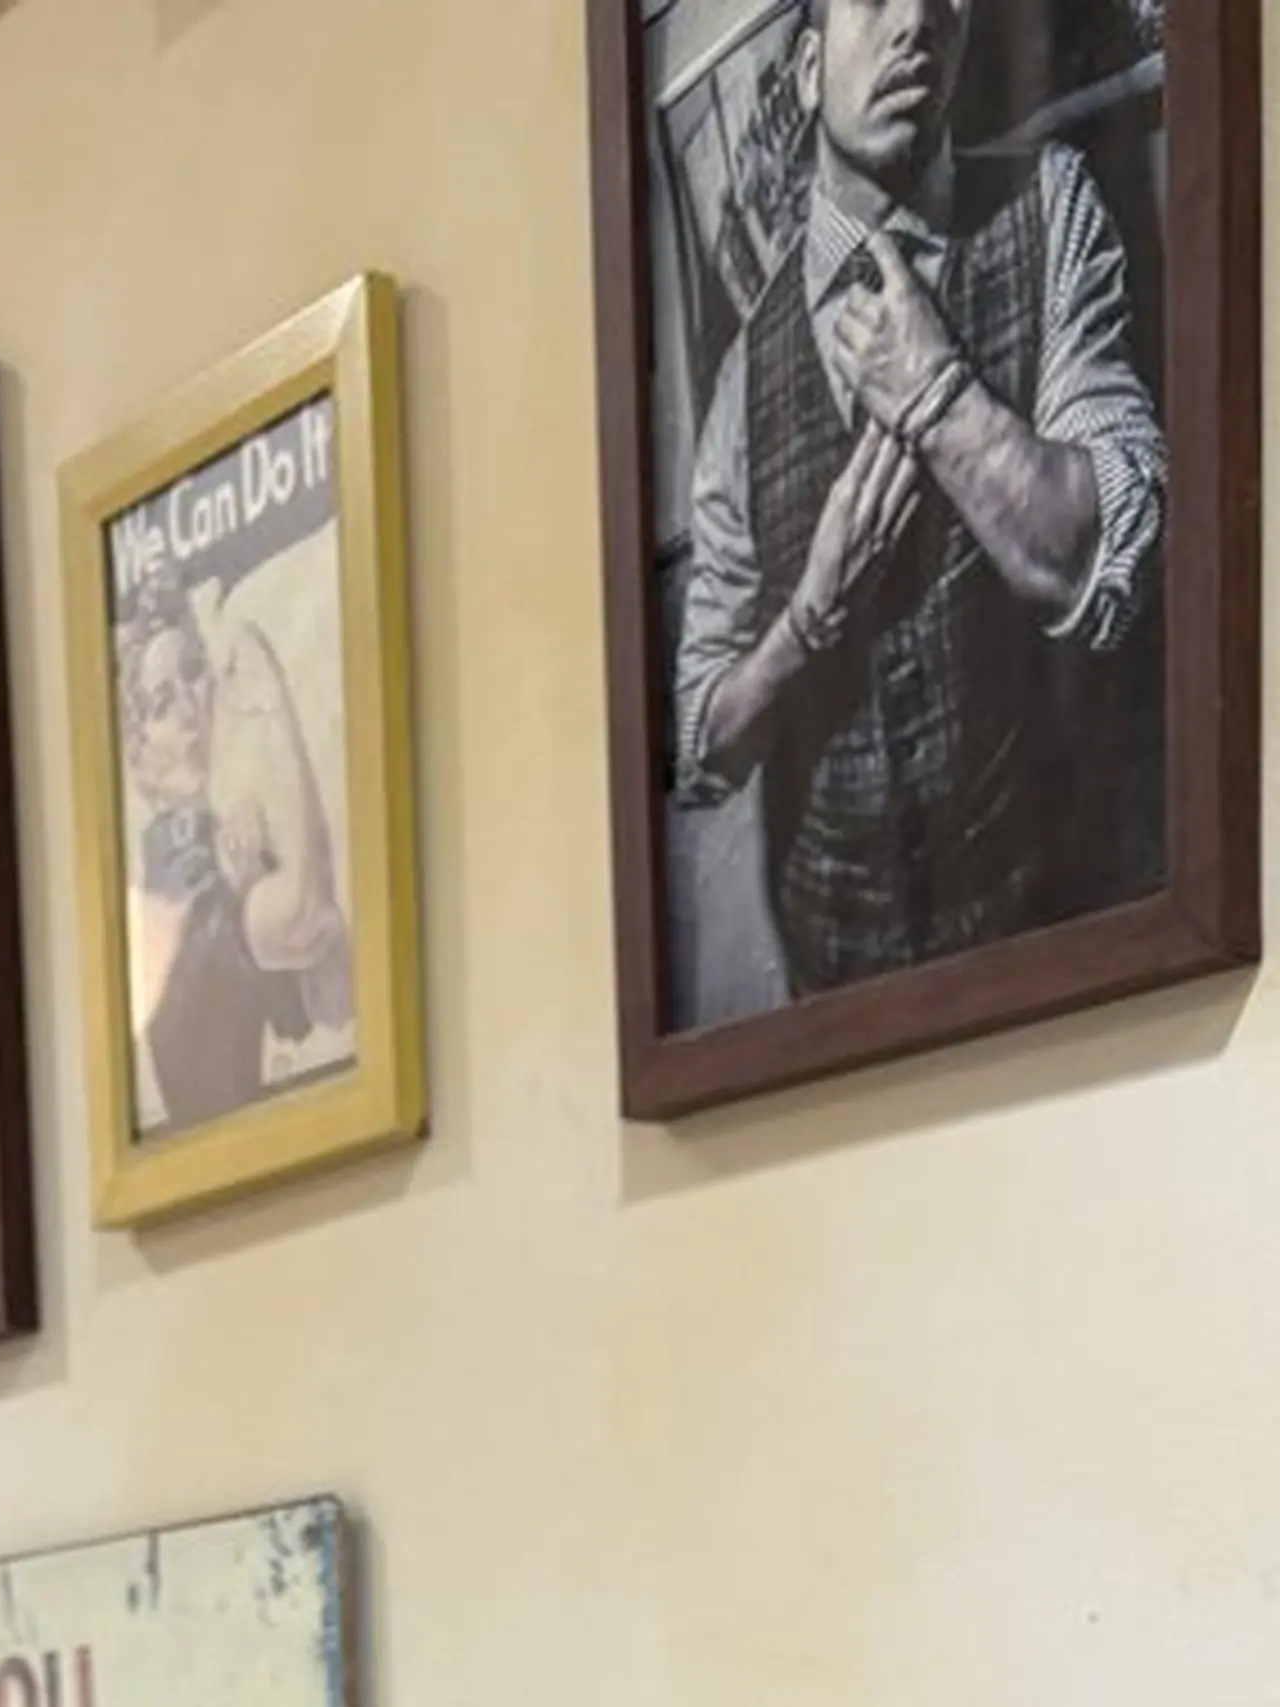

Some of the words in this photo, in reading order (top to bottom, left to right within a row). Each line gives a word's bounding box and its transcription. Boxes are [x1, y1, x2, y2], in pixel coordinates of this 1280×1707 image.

[169, 479, 237, 561] Can
[241, 438, 295, 523] Do
[301, 409, 329, 489] It
